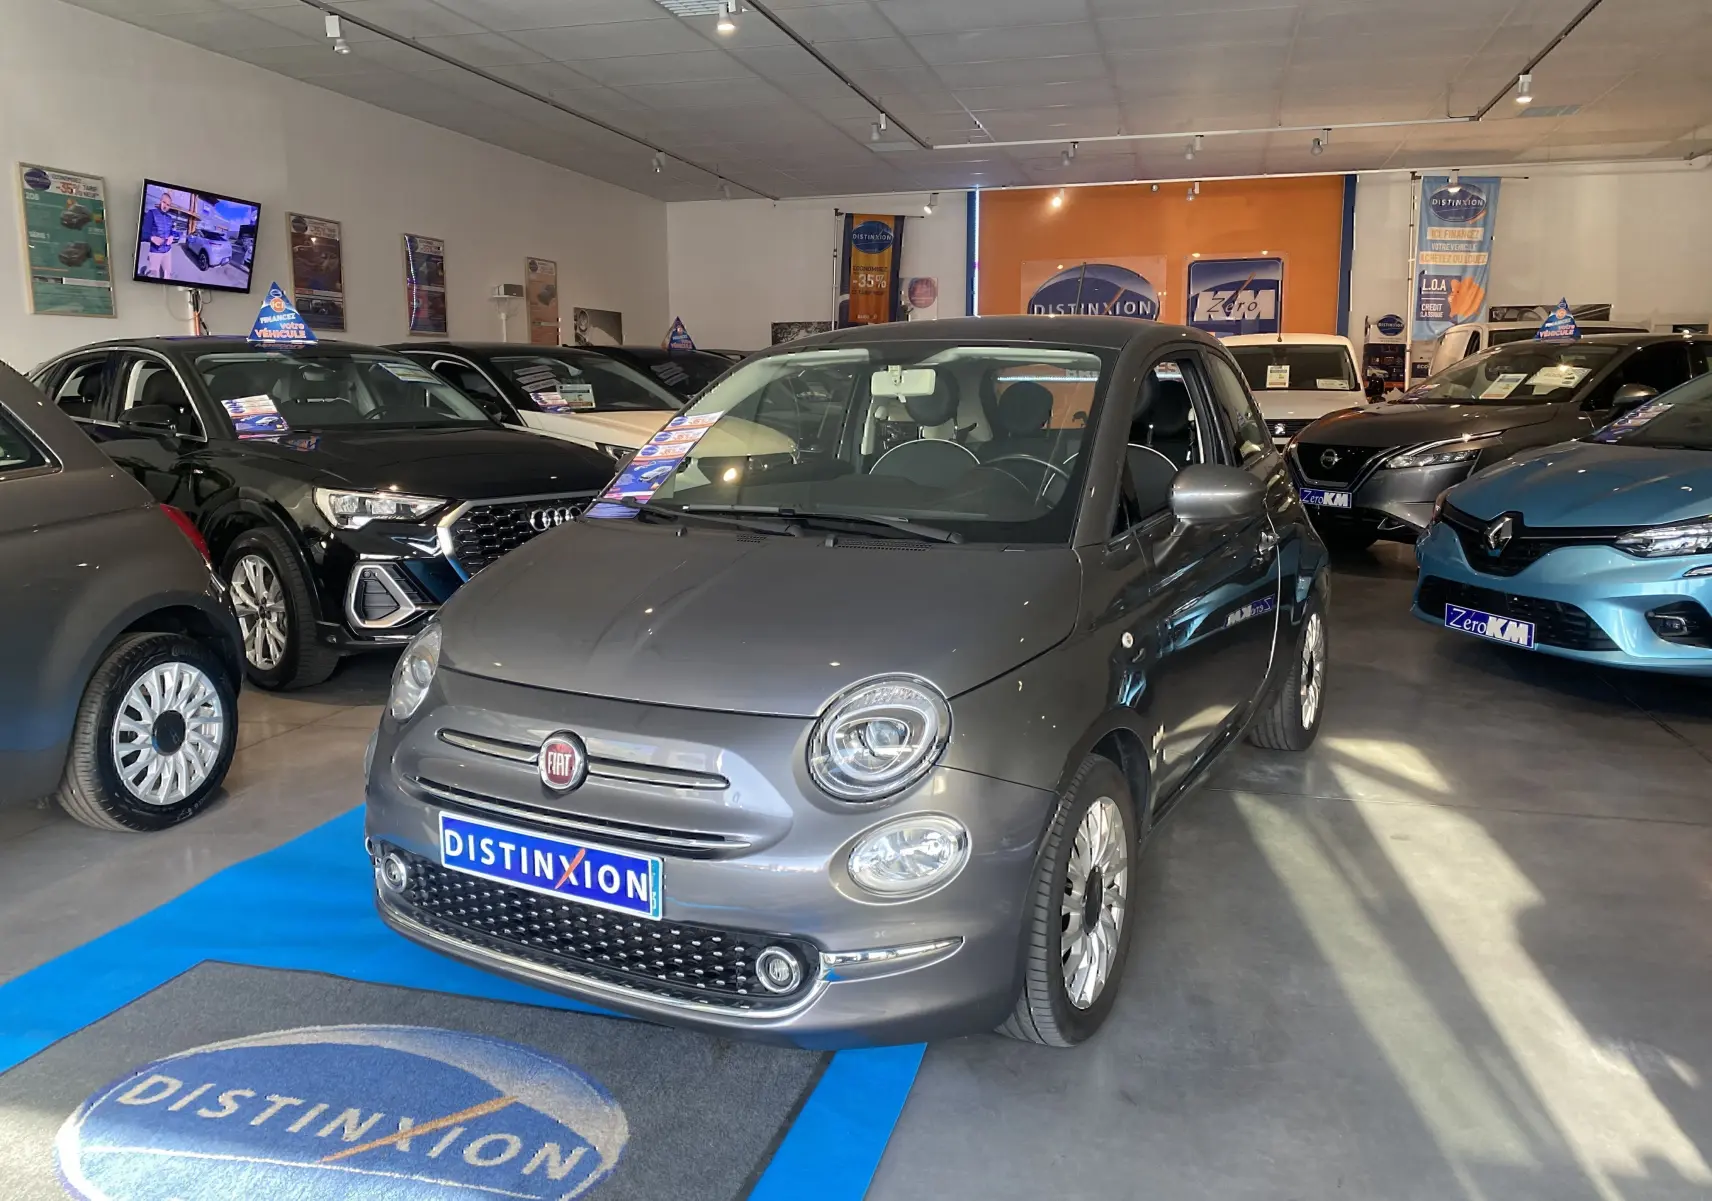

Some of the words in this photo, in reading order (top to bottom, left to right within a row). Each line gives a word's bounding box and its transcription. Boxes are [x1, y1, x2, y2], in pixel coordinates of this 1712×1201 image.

[1431, 198, 1483, 207] DISTINXION
[852, 233, 892, 241] DISTINXION
[852, 273, 887, 289] -35%
[1422, 278, 1447, 292] L.O.A
[1033, 300, 1152, 316] DISTINXION
[260, 313, 296, 324] FINANCEZ
[279, 322, 305, 330] votre
[254, 328, 307, 339] VÉHICULE
[547, 751, 572, 776] FIAT
[443, 828, 649, 902] DISTINXION
[116, 1074, 591, 1180] DISTINXION
